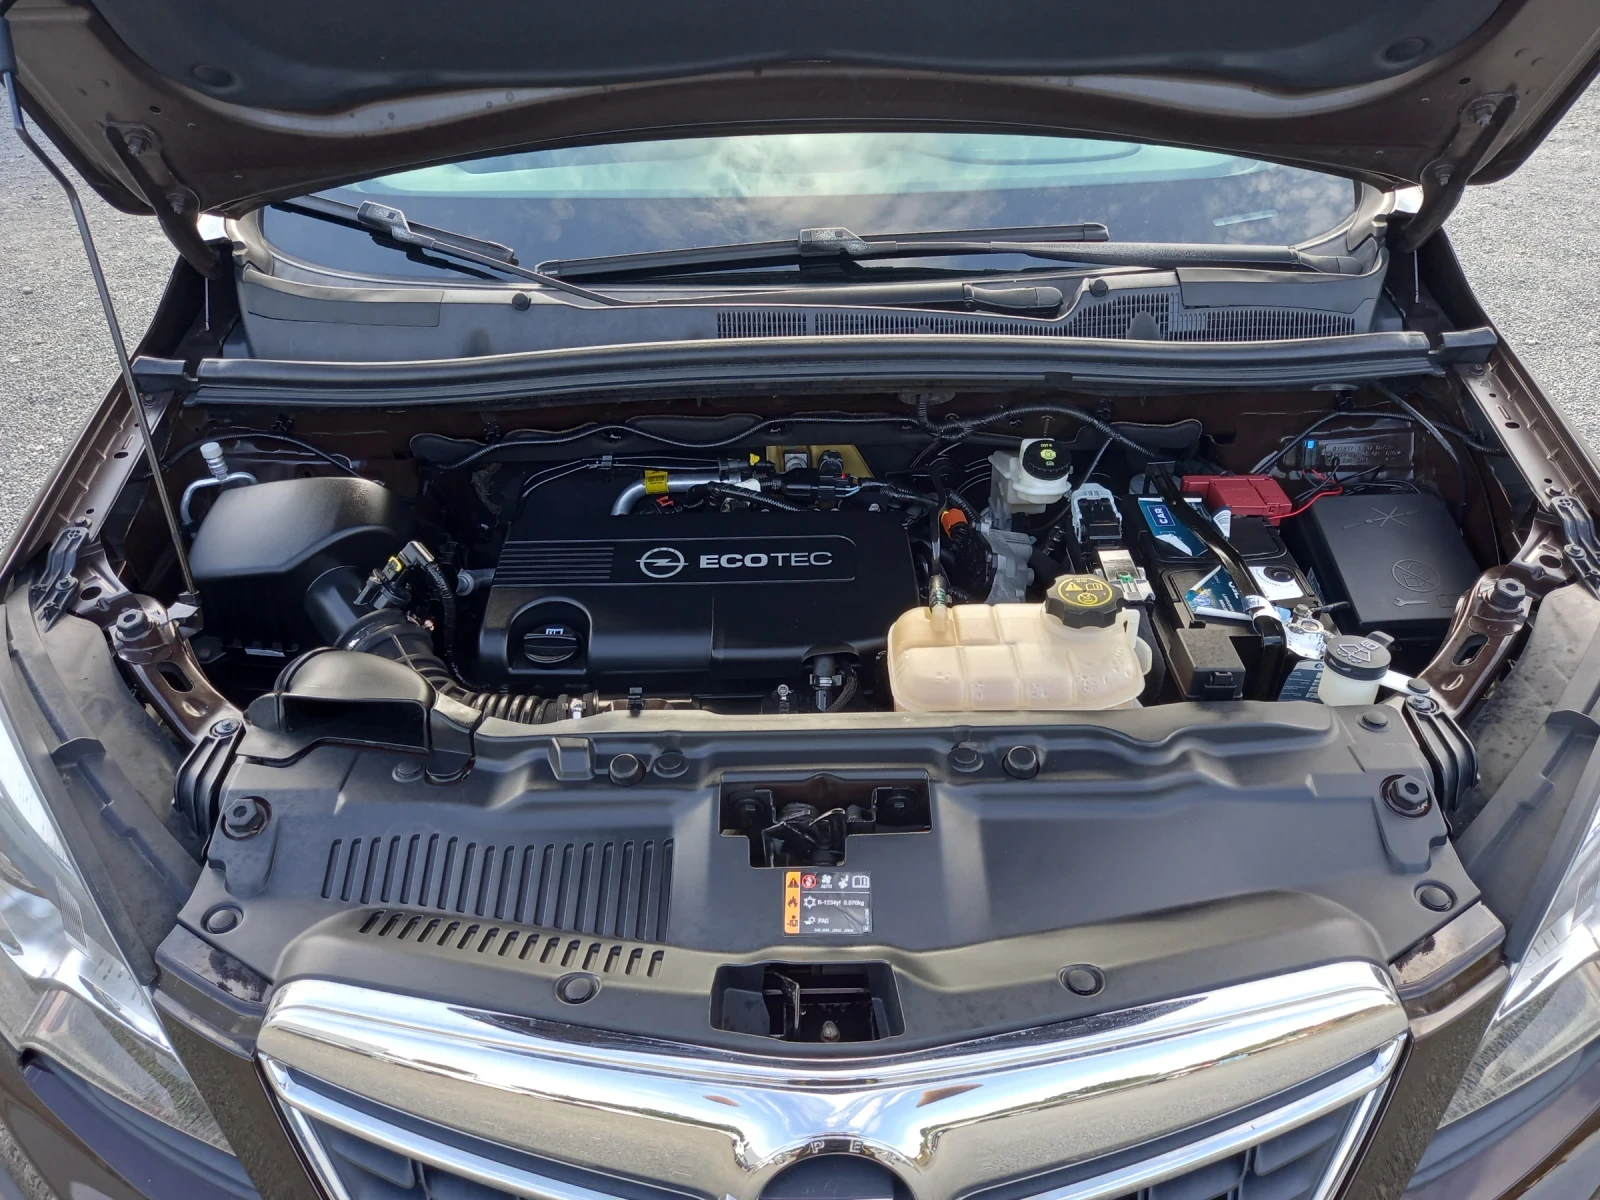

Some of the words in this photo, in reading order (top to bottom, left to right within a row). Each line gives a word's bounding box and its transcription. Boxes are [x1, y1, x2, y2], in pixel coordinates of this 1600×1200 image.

[1154, 507, 1169, 525] CAR
[699, 551, 834, 569] ECOTEC
[817, 899, 842, 907] R-1234yf
